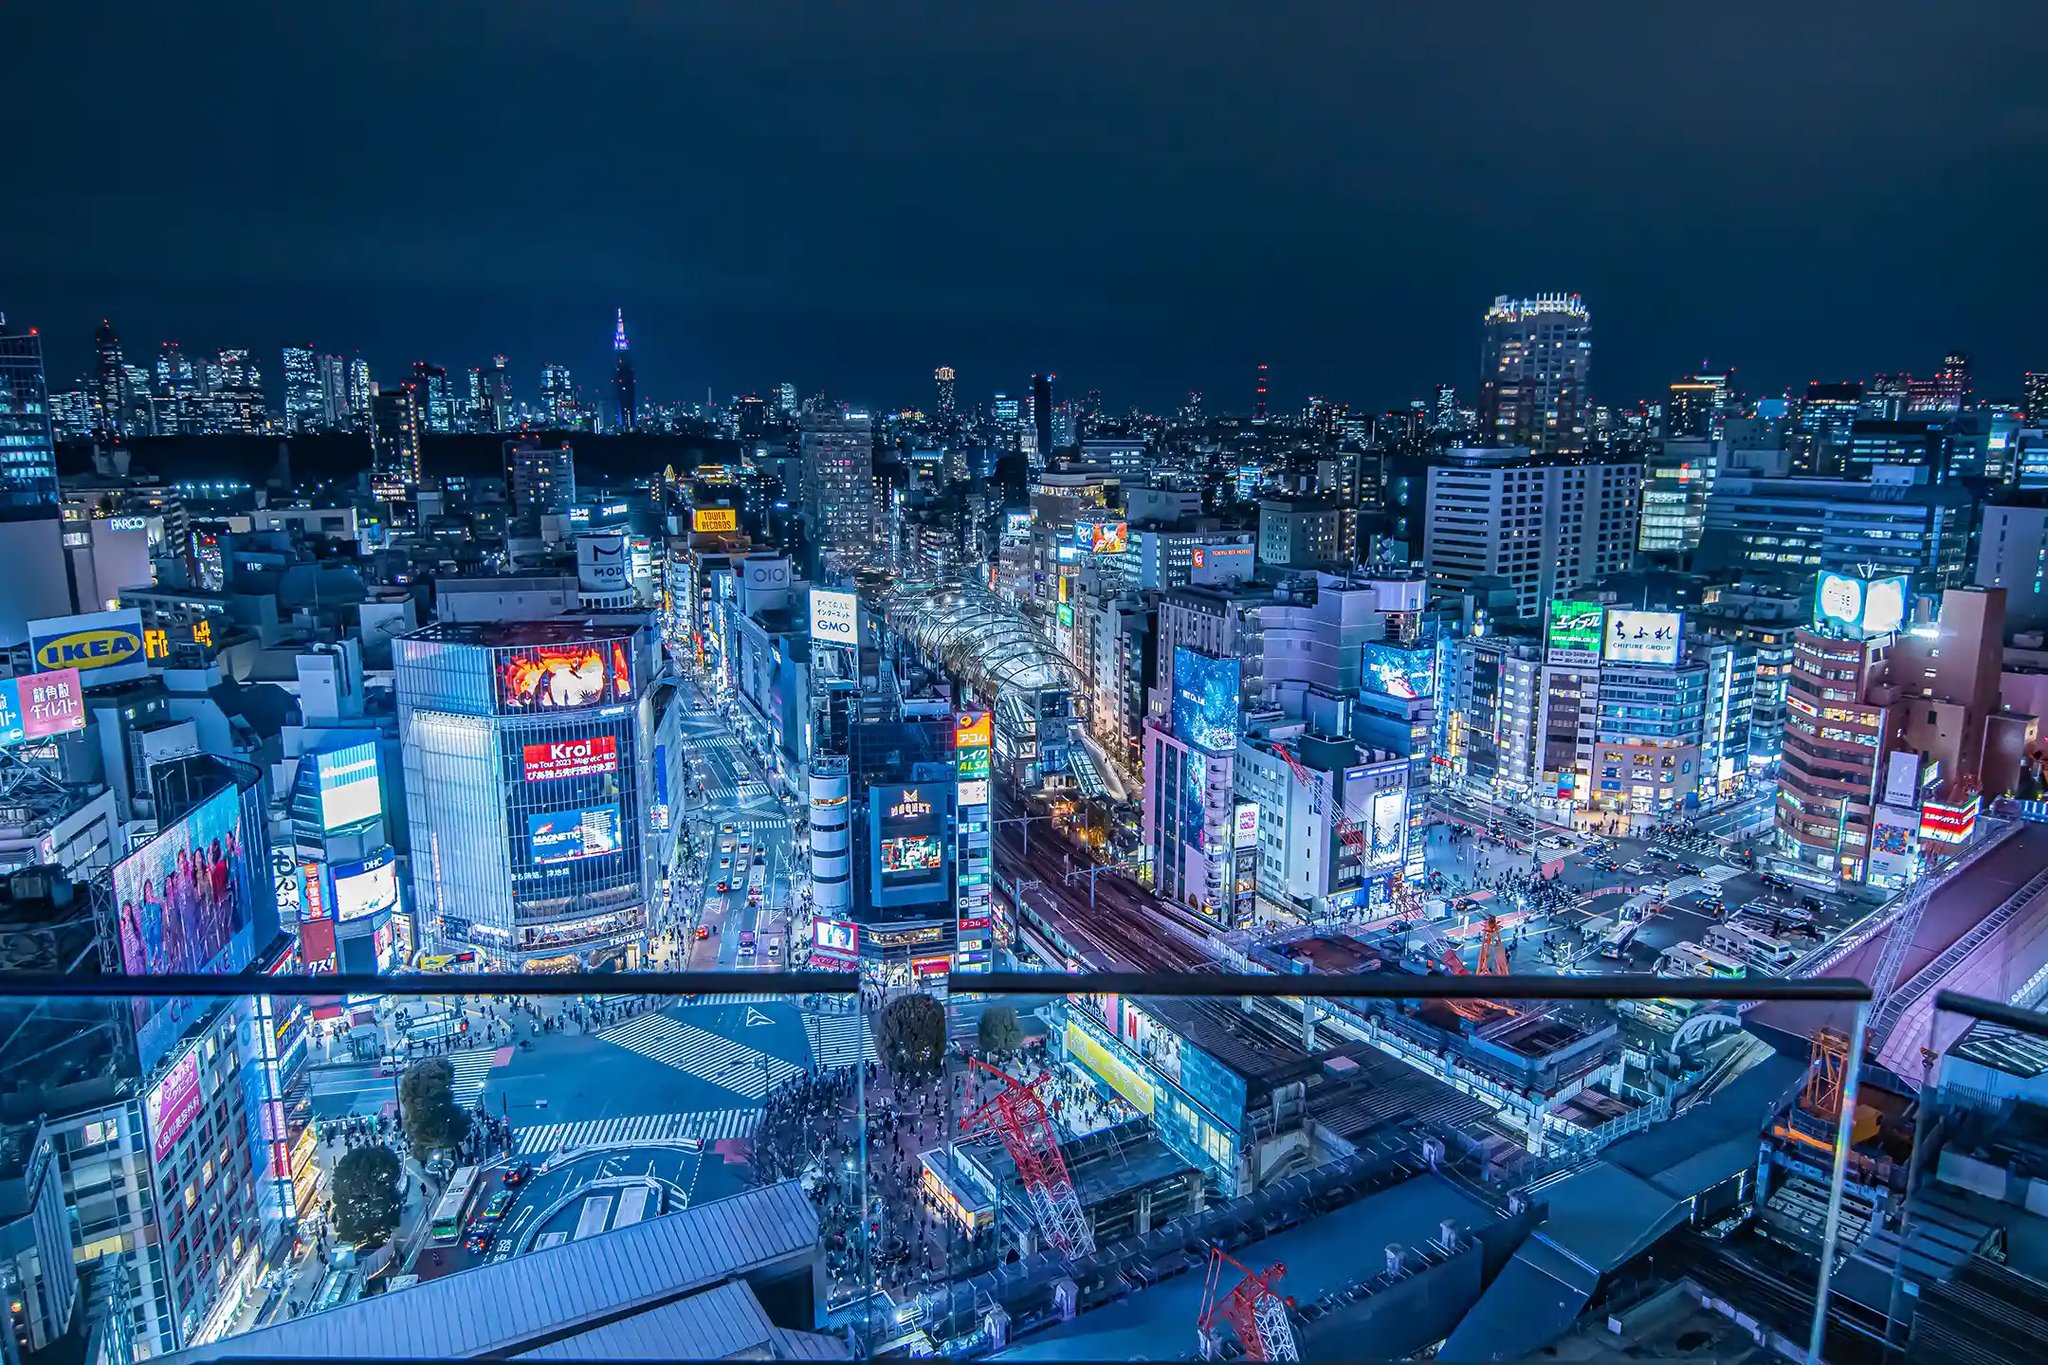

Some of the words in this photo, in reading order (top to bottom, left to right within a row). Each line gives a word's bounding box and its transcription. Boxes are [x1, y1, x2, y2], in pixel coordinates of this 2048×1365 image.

[703, 512, 727, 520] TOWER
[111, 516, 146, 531] PARCO
[701, 521, 732, 530] RECORDS
[817, 620, 850, 633] GMO
[1550, 612, 1602, 630] エイブル
[1615, 620, 1673, 640] ちふれ
[47, 636, 135, 664] IKEA
[959, 733, 987, 744] アコム
[550, 740, 592, 760] Kroi
[960, 749, 988, 761] レイク
[555, 758, 571, 767] 2023
[959, 760, 988, 771] ALSA
[532, 831, 581, 844] MAGNETIC
[363, 857, 384, 872] DHC
[608, 931, 646, 946] TSUTAYA
